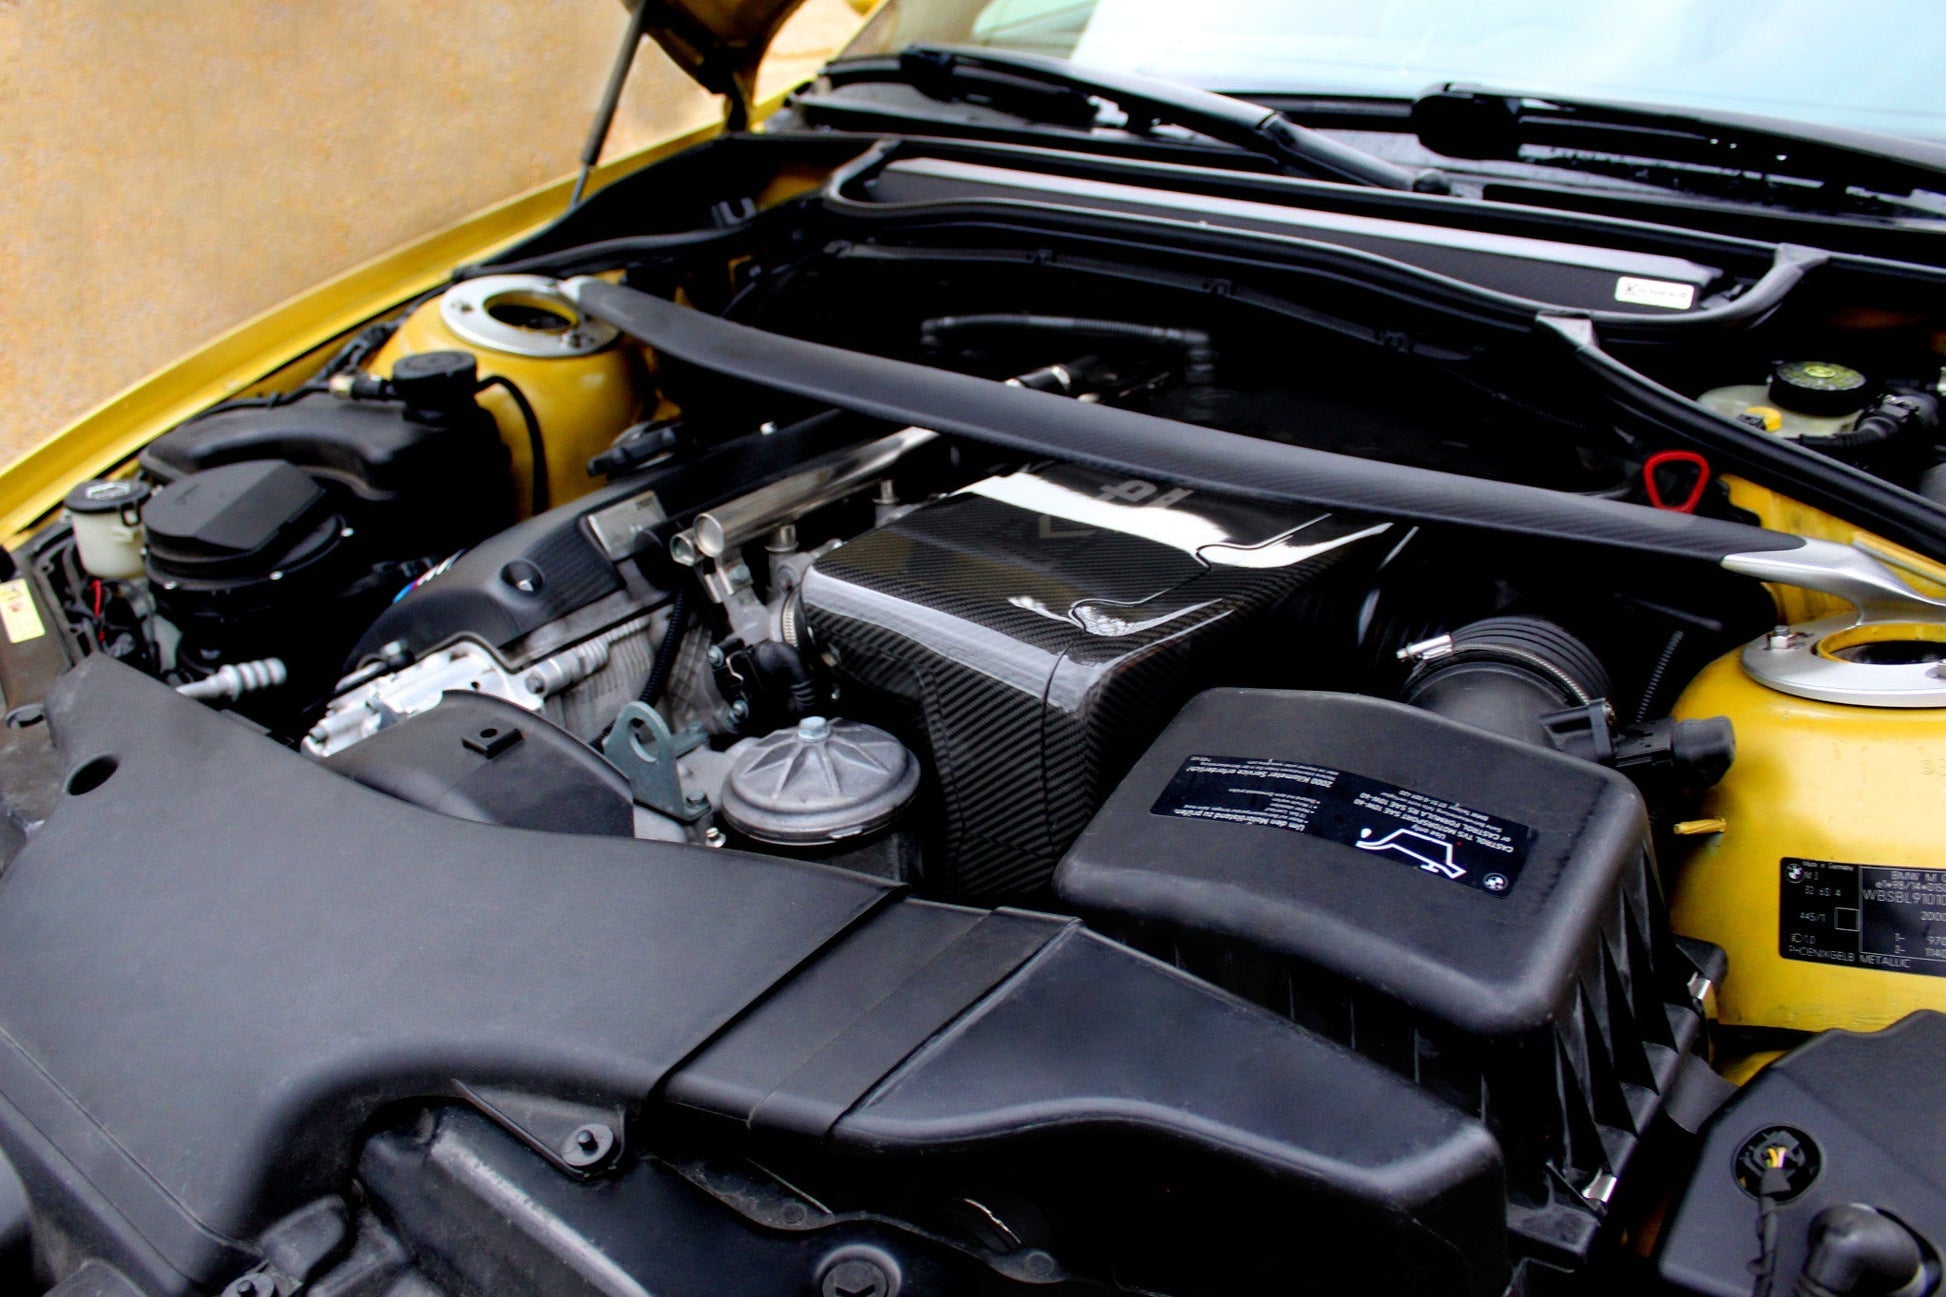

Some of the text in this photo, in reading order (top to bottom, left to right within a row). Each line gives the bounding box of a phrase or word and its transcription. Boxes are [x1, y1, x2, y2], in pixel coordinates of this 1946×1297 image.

[1237, 770, 1268, 778] Service
[1268, 772, 1311, 783] Kilometer
[1401, 814, 1457, 834] MOTORSPORT
[1420, 811, 1461, 827] FORMULA
[1462, 824, 1500, 840] CASTROL
[1475, 837, 1514, 853] CASTROL
[1891, 871, 1920, 881] BMW
[1860, 954, 1911, 968] METALLIC
